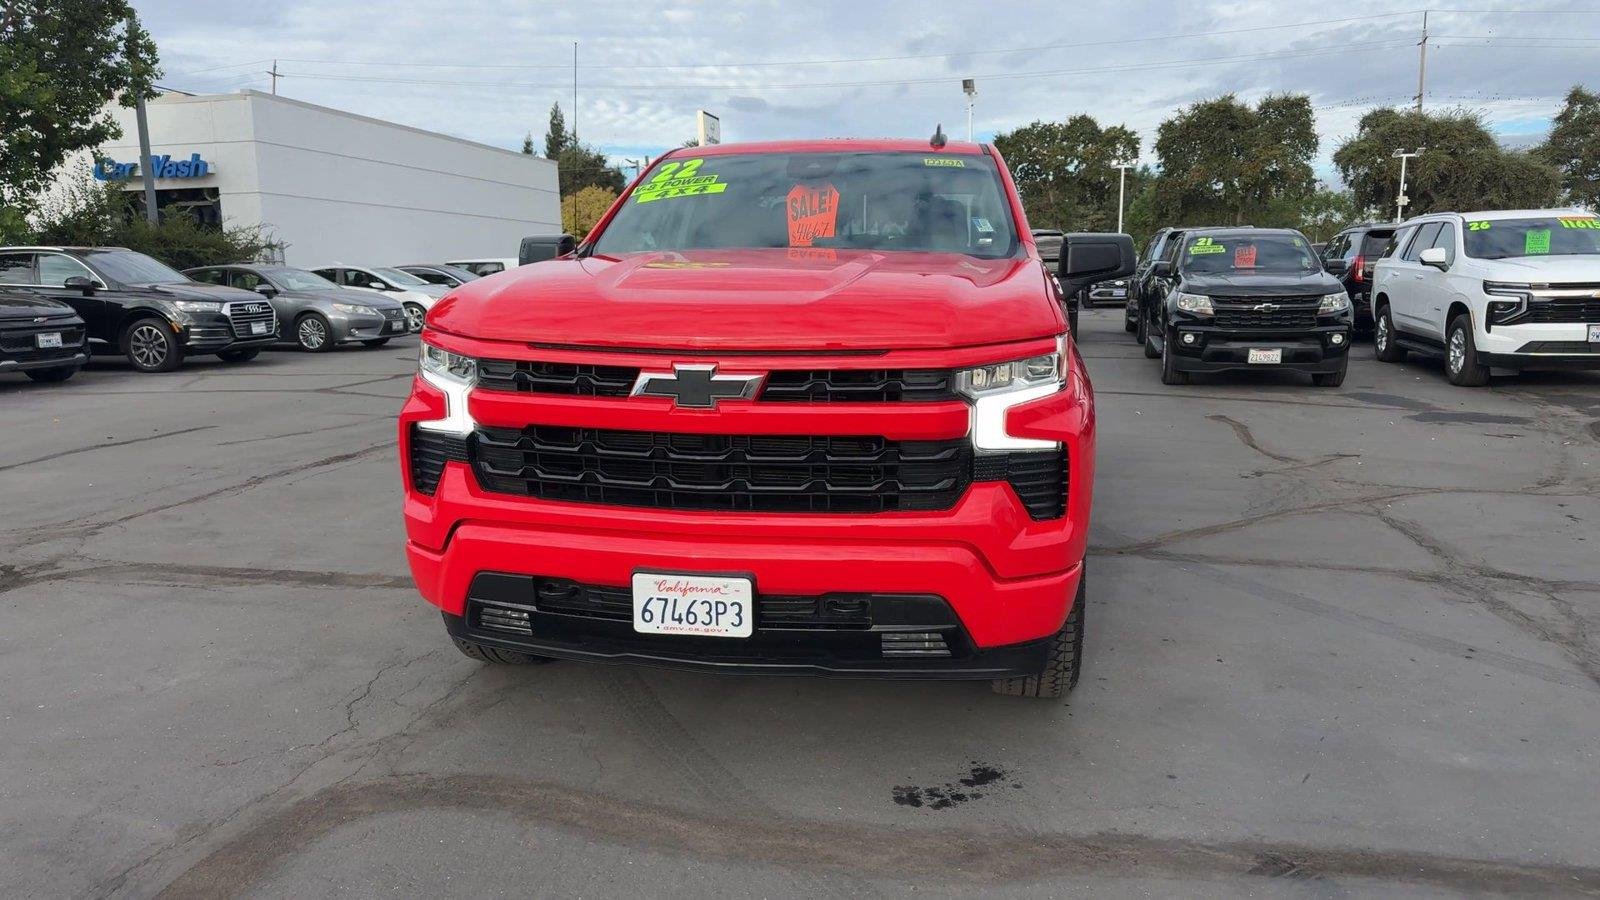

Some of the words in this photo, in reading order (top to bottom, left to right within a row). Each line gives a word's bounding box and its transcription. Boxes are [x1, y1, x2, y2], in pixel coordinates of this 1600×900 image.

[93, 157, 138, 180] Car
[141, 153, 208, 178] Wash
[651, 158, 704, 182] 22
[659, 175, 715, 189] POWER
[790, 187, 833, 222] SALE!
[1469, 221, 1491, 231] 26
[1196, 237, 1212, 246] 21
[656, 579, 729, 597] California
[641, 597, 743, 627] 67463P3
